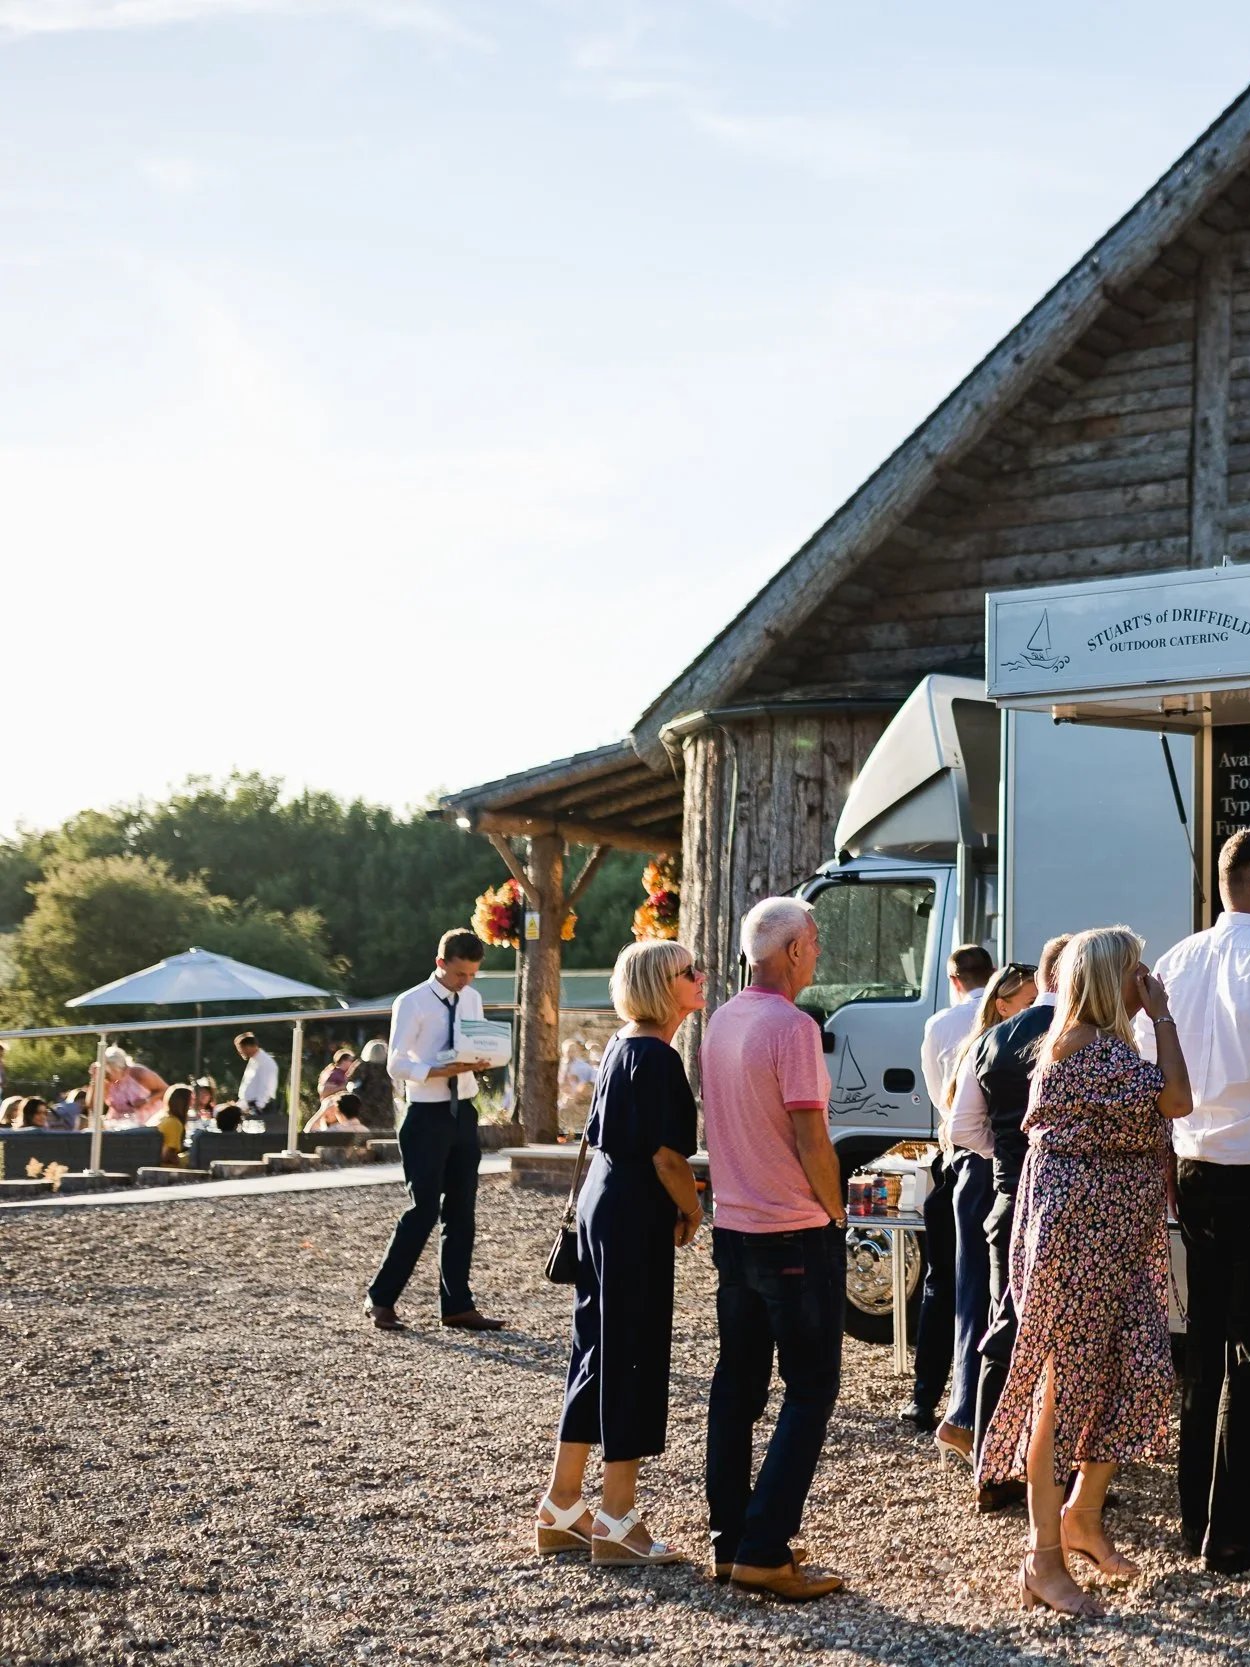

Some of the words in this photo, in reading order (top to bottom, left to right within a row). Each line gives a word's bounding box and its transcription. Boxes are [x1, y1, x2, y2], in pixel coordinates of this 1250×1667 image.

[1087, 613, 1152, 652] STUART'S
[1155, 609, 1169, 624] of
[1109, 638, 1167, 653] OUTDOOR
[1169, 631, 1229, 647] CATERING
